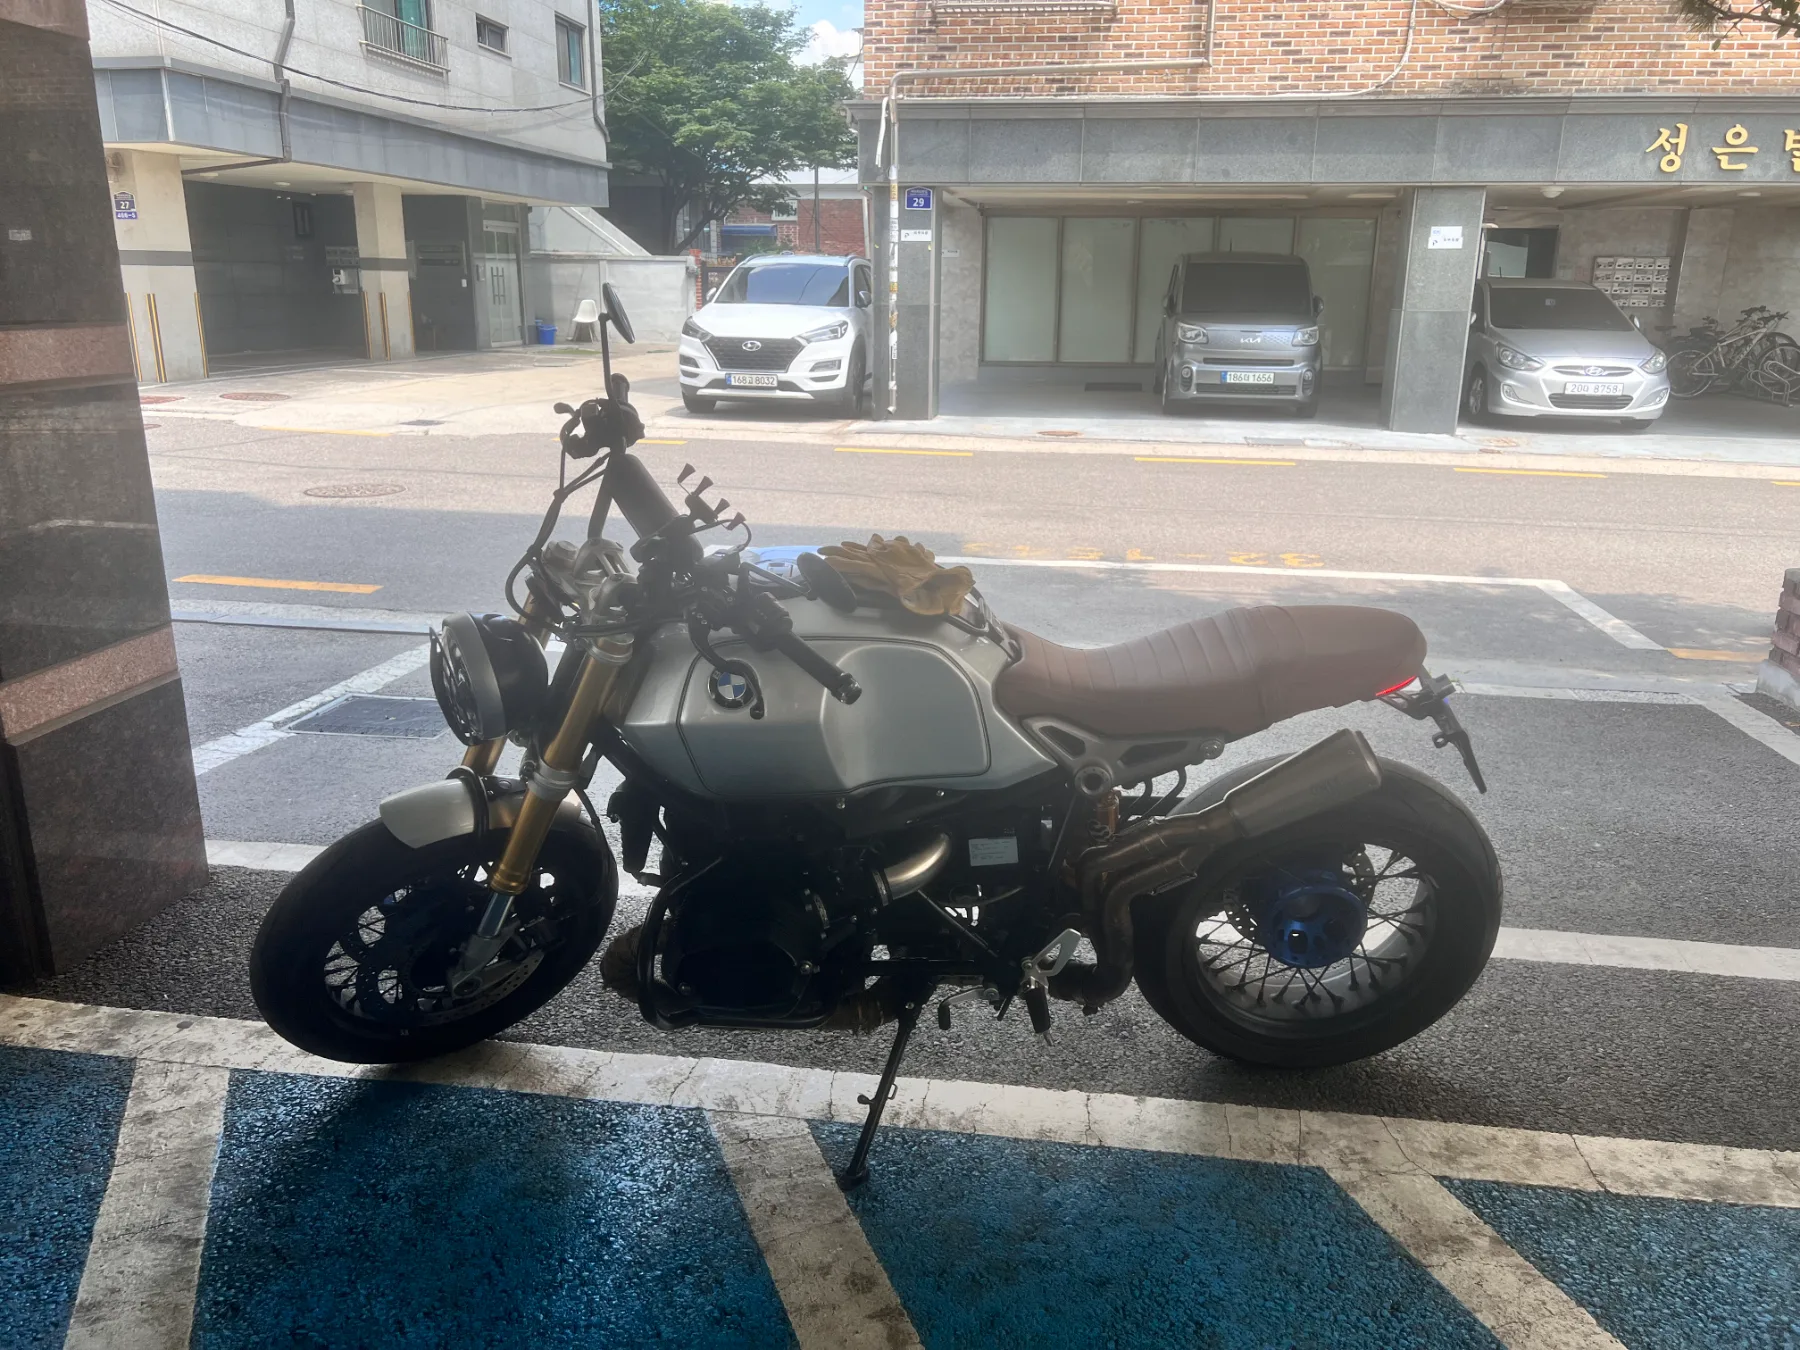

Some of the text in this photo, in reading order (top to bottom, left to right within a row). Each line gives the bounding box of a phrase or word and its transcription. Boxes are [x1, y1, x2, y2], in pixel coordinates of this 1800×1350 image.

[120, 201, 130, 209] 27
[912, 197, 925, 207] 29
[755, 376, 775, 385] 8032
[1252, 373, 1272, 383] 1656
[1594, 385, 1618, 393] 8758
